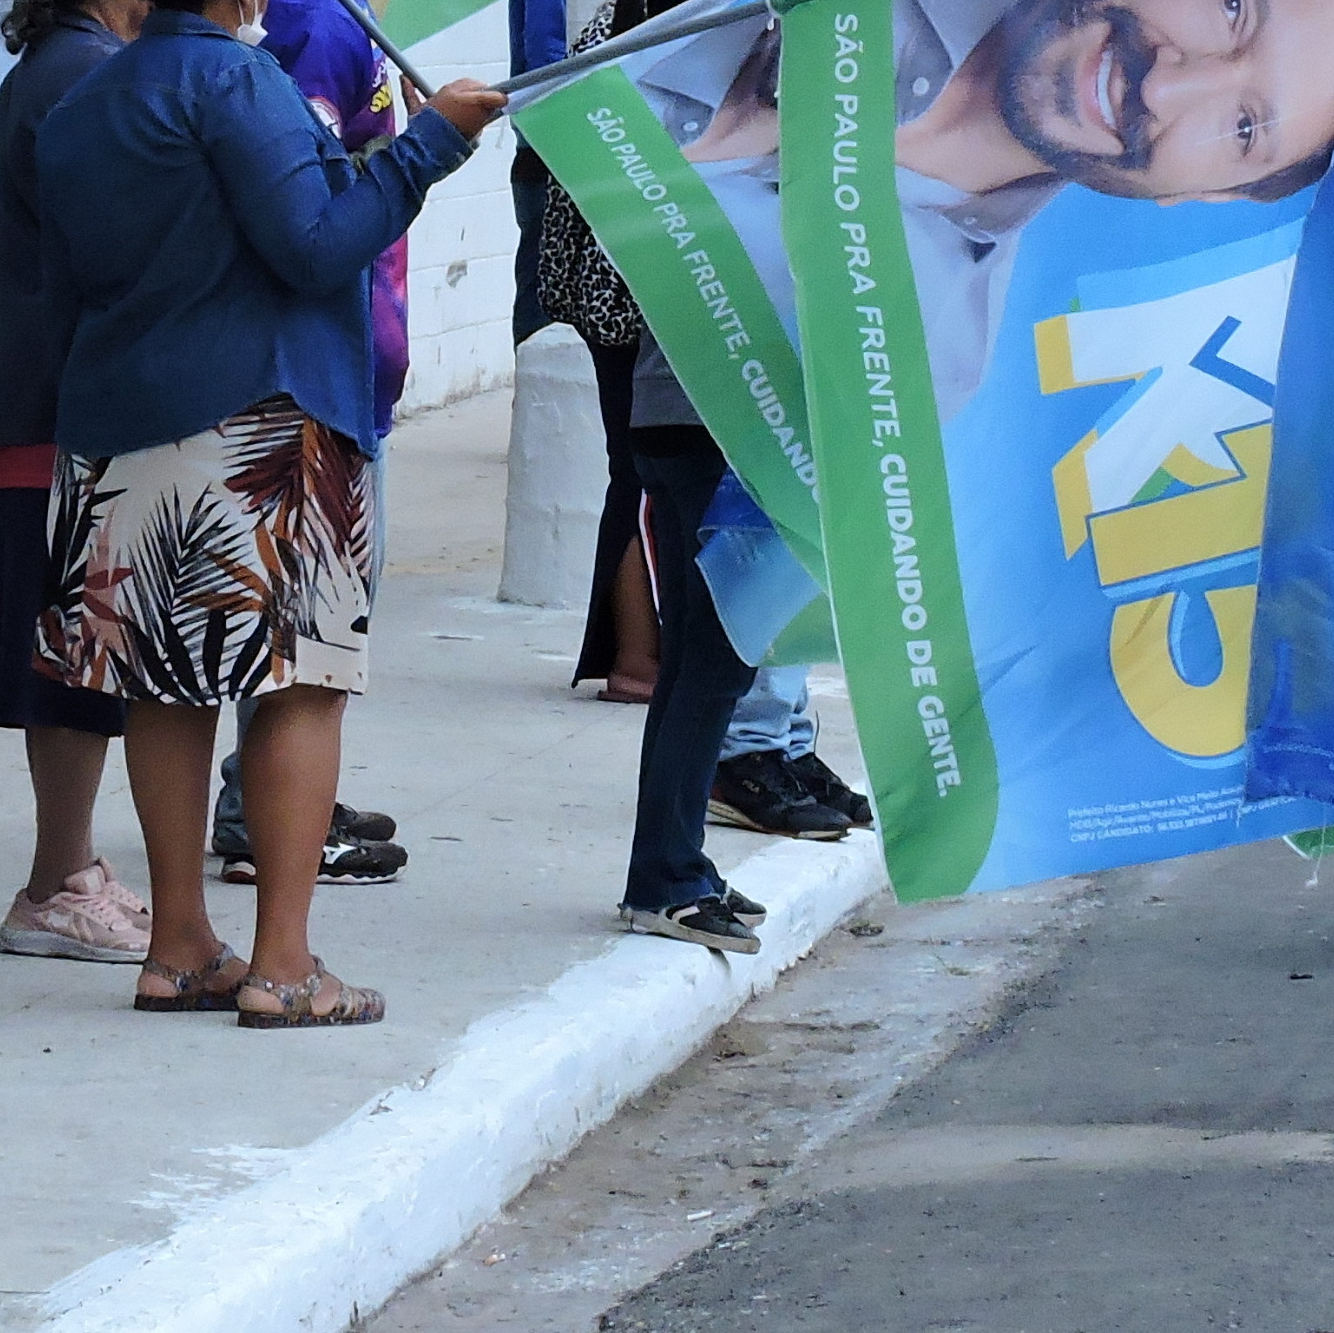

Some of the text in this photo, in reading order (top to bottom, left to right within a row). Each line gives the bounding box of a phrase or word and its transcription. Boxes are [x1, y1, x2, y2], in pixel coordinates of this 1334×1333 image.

[587, 107, 625, 145] SÃO
[610, 142, 666, 202] PAULO
[652, 190, 695, 251] PRA
[683, 250, 753, 361] FRENTE,
[832, 13, 962, 798] SÃO PAULO PRA FRENTE, CUIDANDO DE GENTE.
